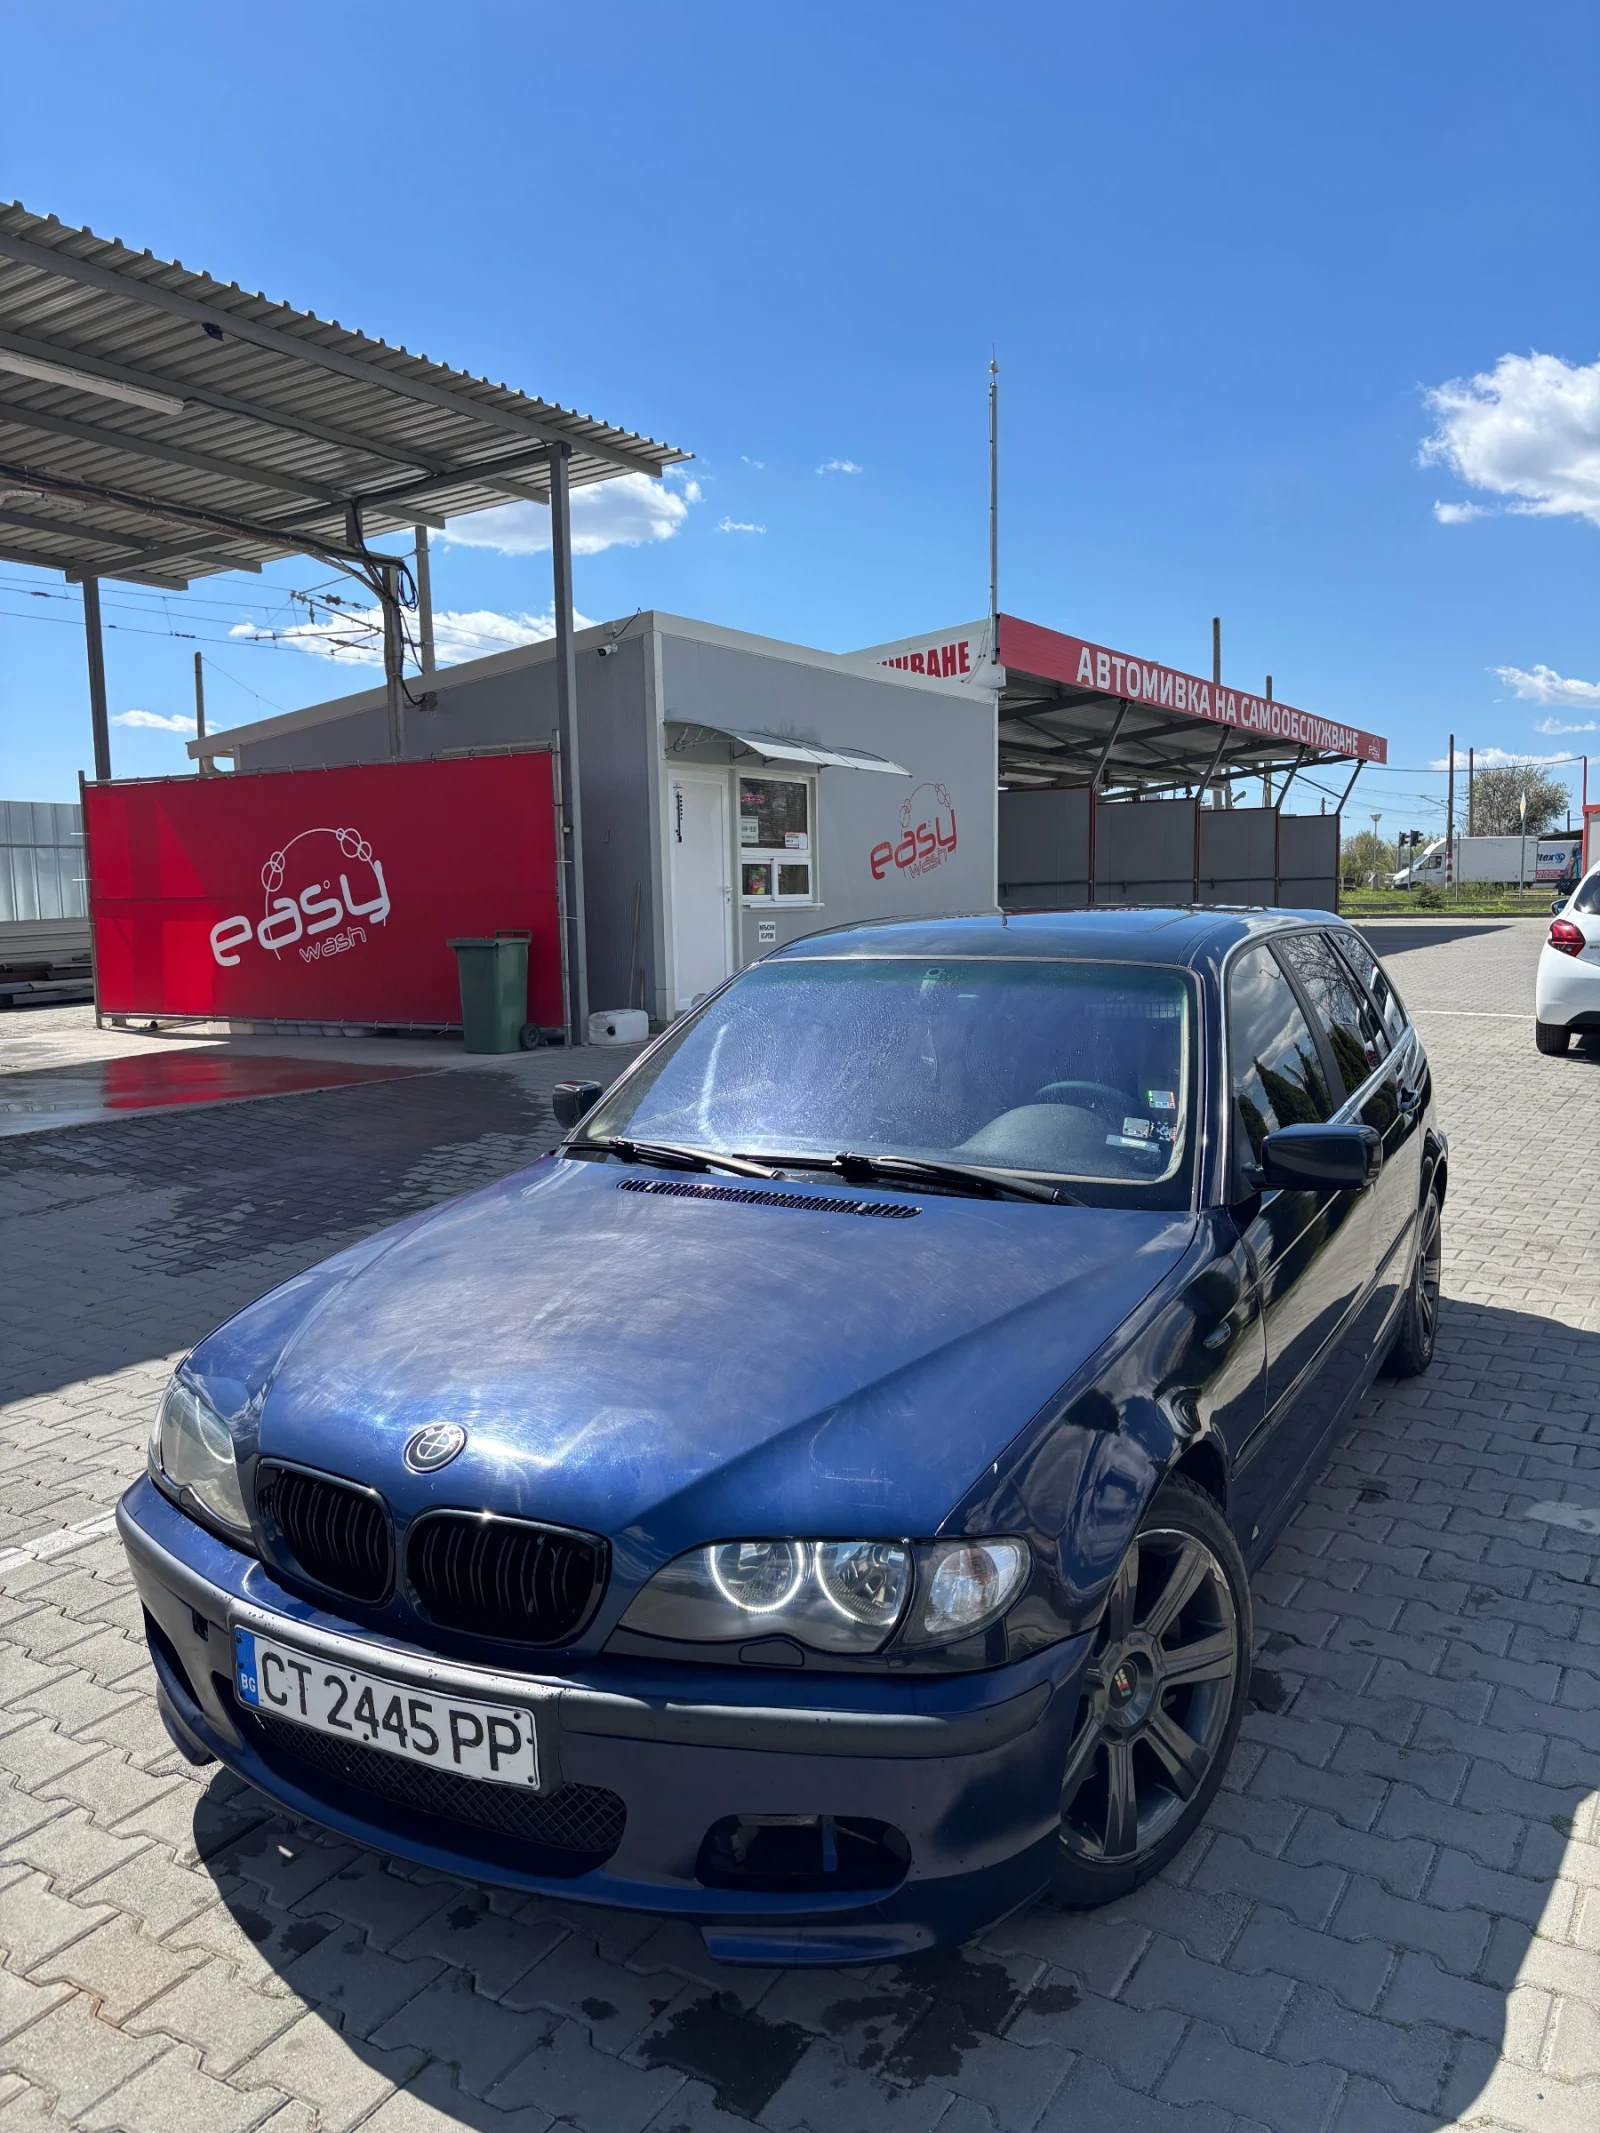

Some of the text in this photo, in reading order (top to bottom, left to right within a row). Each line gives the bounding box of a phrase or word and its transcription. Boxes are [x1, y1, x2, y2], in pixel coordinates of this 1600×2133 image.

[1076, 647, 1359, 755] АВТОМИВКА НА САМООБСЛУЖВАНЕ
[870, 808, 957, 880] easy
[908, 847, 948, 879] wash
[210, 859, 391, 967] easy
[299, 926, 367, 963] wash
[241, 1673, 257, 1694] BG
[261, 1651, 522, 1772] CT 2445 PP
